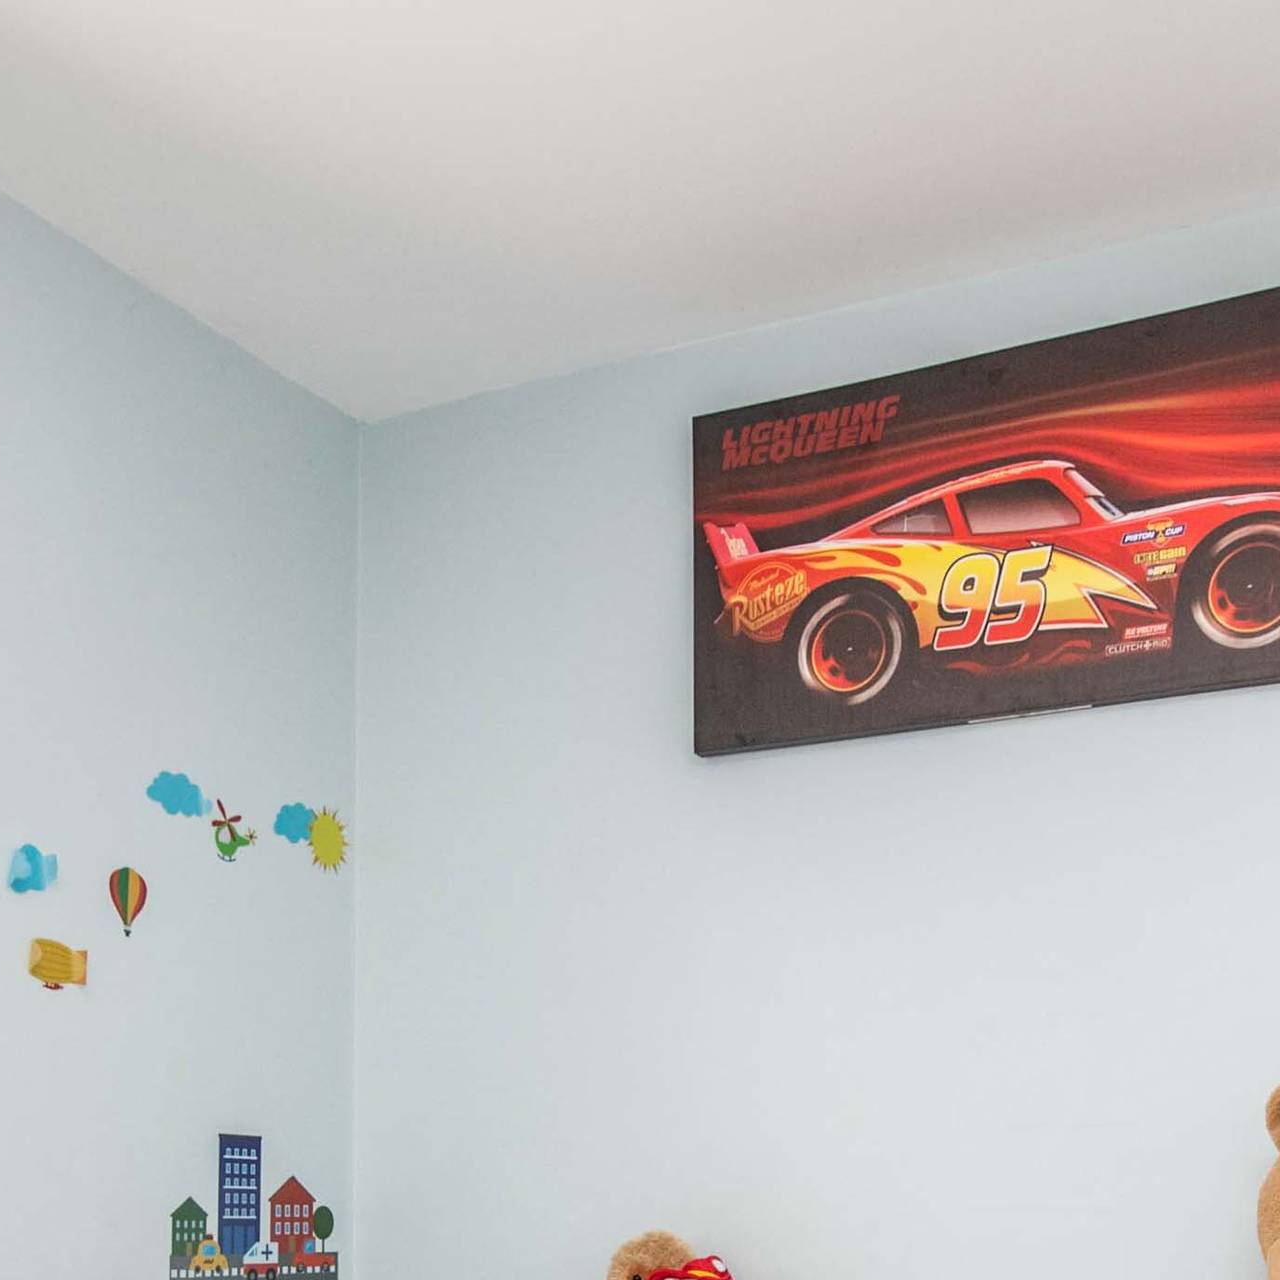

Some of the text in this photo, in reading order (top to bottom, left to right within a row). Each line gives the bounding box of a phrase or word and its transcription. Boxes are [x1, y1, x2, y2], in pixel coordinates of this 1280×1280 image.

[722, 395, 900, 450] LIGHTNING
[1165, 526, 1183, 536] CUP
[933, 543, 1054, 651] 95
[1108, 643, 1144, 655] CLUTCH
